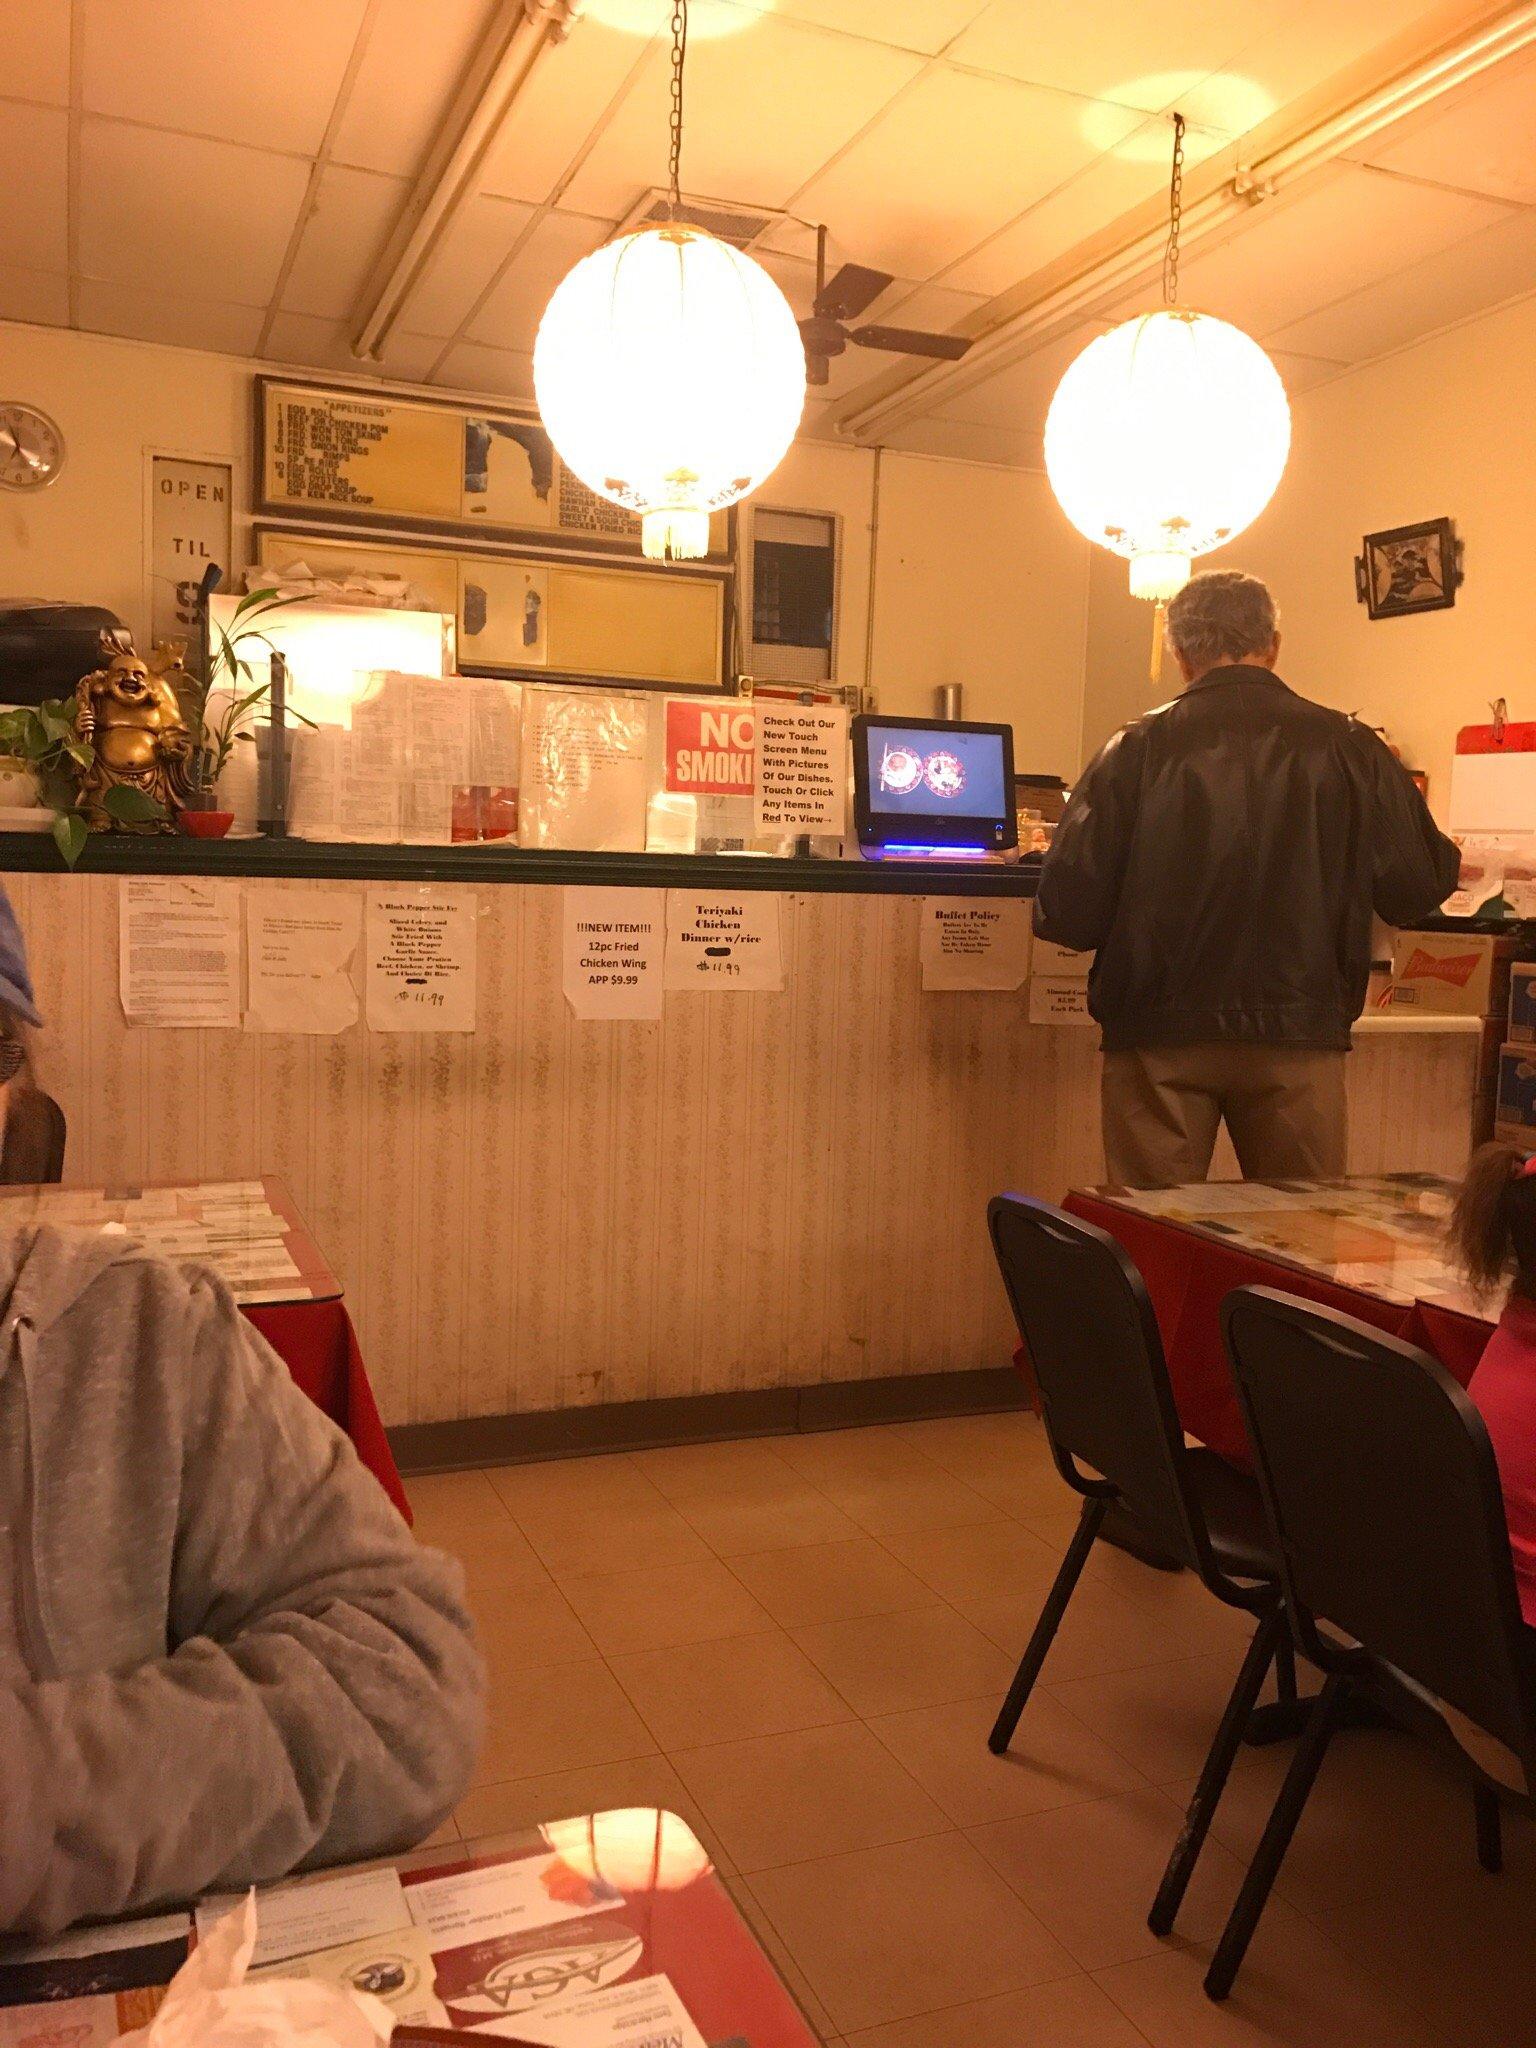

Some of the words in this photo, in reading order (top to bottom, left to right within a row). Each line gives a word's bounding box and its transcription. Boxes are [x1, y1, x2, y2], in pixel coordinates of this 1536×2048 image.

[160, 478, 224, 502] OPEN
[172, 537, 211, 558] TIL
[176, 581, 203, 625] 9
[763, 716, 795, 726] Check
[798, 718, 815, 728] Out
[818, 719, 836, 729] Our
[700, 711, 755, 750] NO
[763, 730, 786, 740] New
[789, 731, 819, 741] Touch
[763, 744, 798, 754] Screen
[801, 746, 827, 756] Menu
[763, 758, 786, 767] With
[788, 759, 829, 769] Pictures
[763, 771, 775, 781] Of
[778, 772, 795, 782] Our
[798, 773, 834, 783] Dishes.
[762, 785, 793, 795] Touch
[795, 786, 807, 796] Or
[810, 787, 834, 797] Click
[762, 799, 781, 809] Any
[784, 800, 812, 810] Items
[814, 801, 824, 810] In
[762, 812, 781, 823] Red
[784, 814, 796, 823] To
[799, 814, 824, 824] View
[695, 905, 744, 918] Teriyaki
[935, 910, 967, 920] Buffet
[970, 911, 1000, 922] Policy
[576, 922, 612, 934] !!!NEW
[615, 923, 652, 934] ITEM!!!
[695, 918, 742, 929] Chicken
[681, 932, 721, 943] Dinner
[724, 933, 762, 944] w/rice
[588, 942, 612, 953] 12pc
[614, 941, 639, 952] Fried
[580, 958, 619, 969] Chicken
[621, 958, 647, 970] Wing
[588, 975, 609, 985] APP
[611, 974, 638, 986] $9.99
[471, 1950, 606, 2008] AGA
